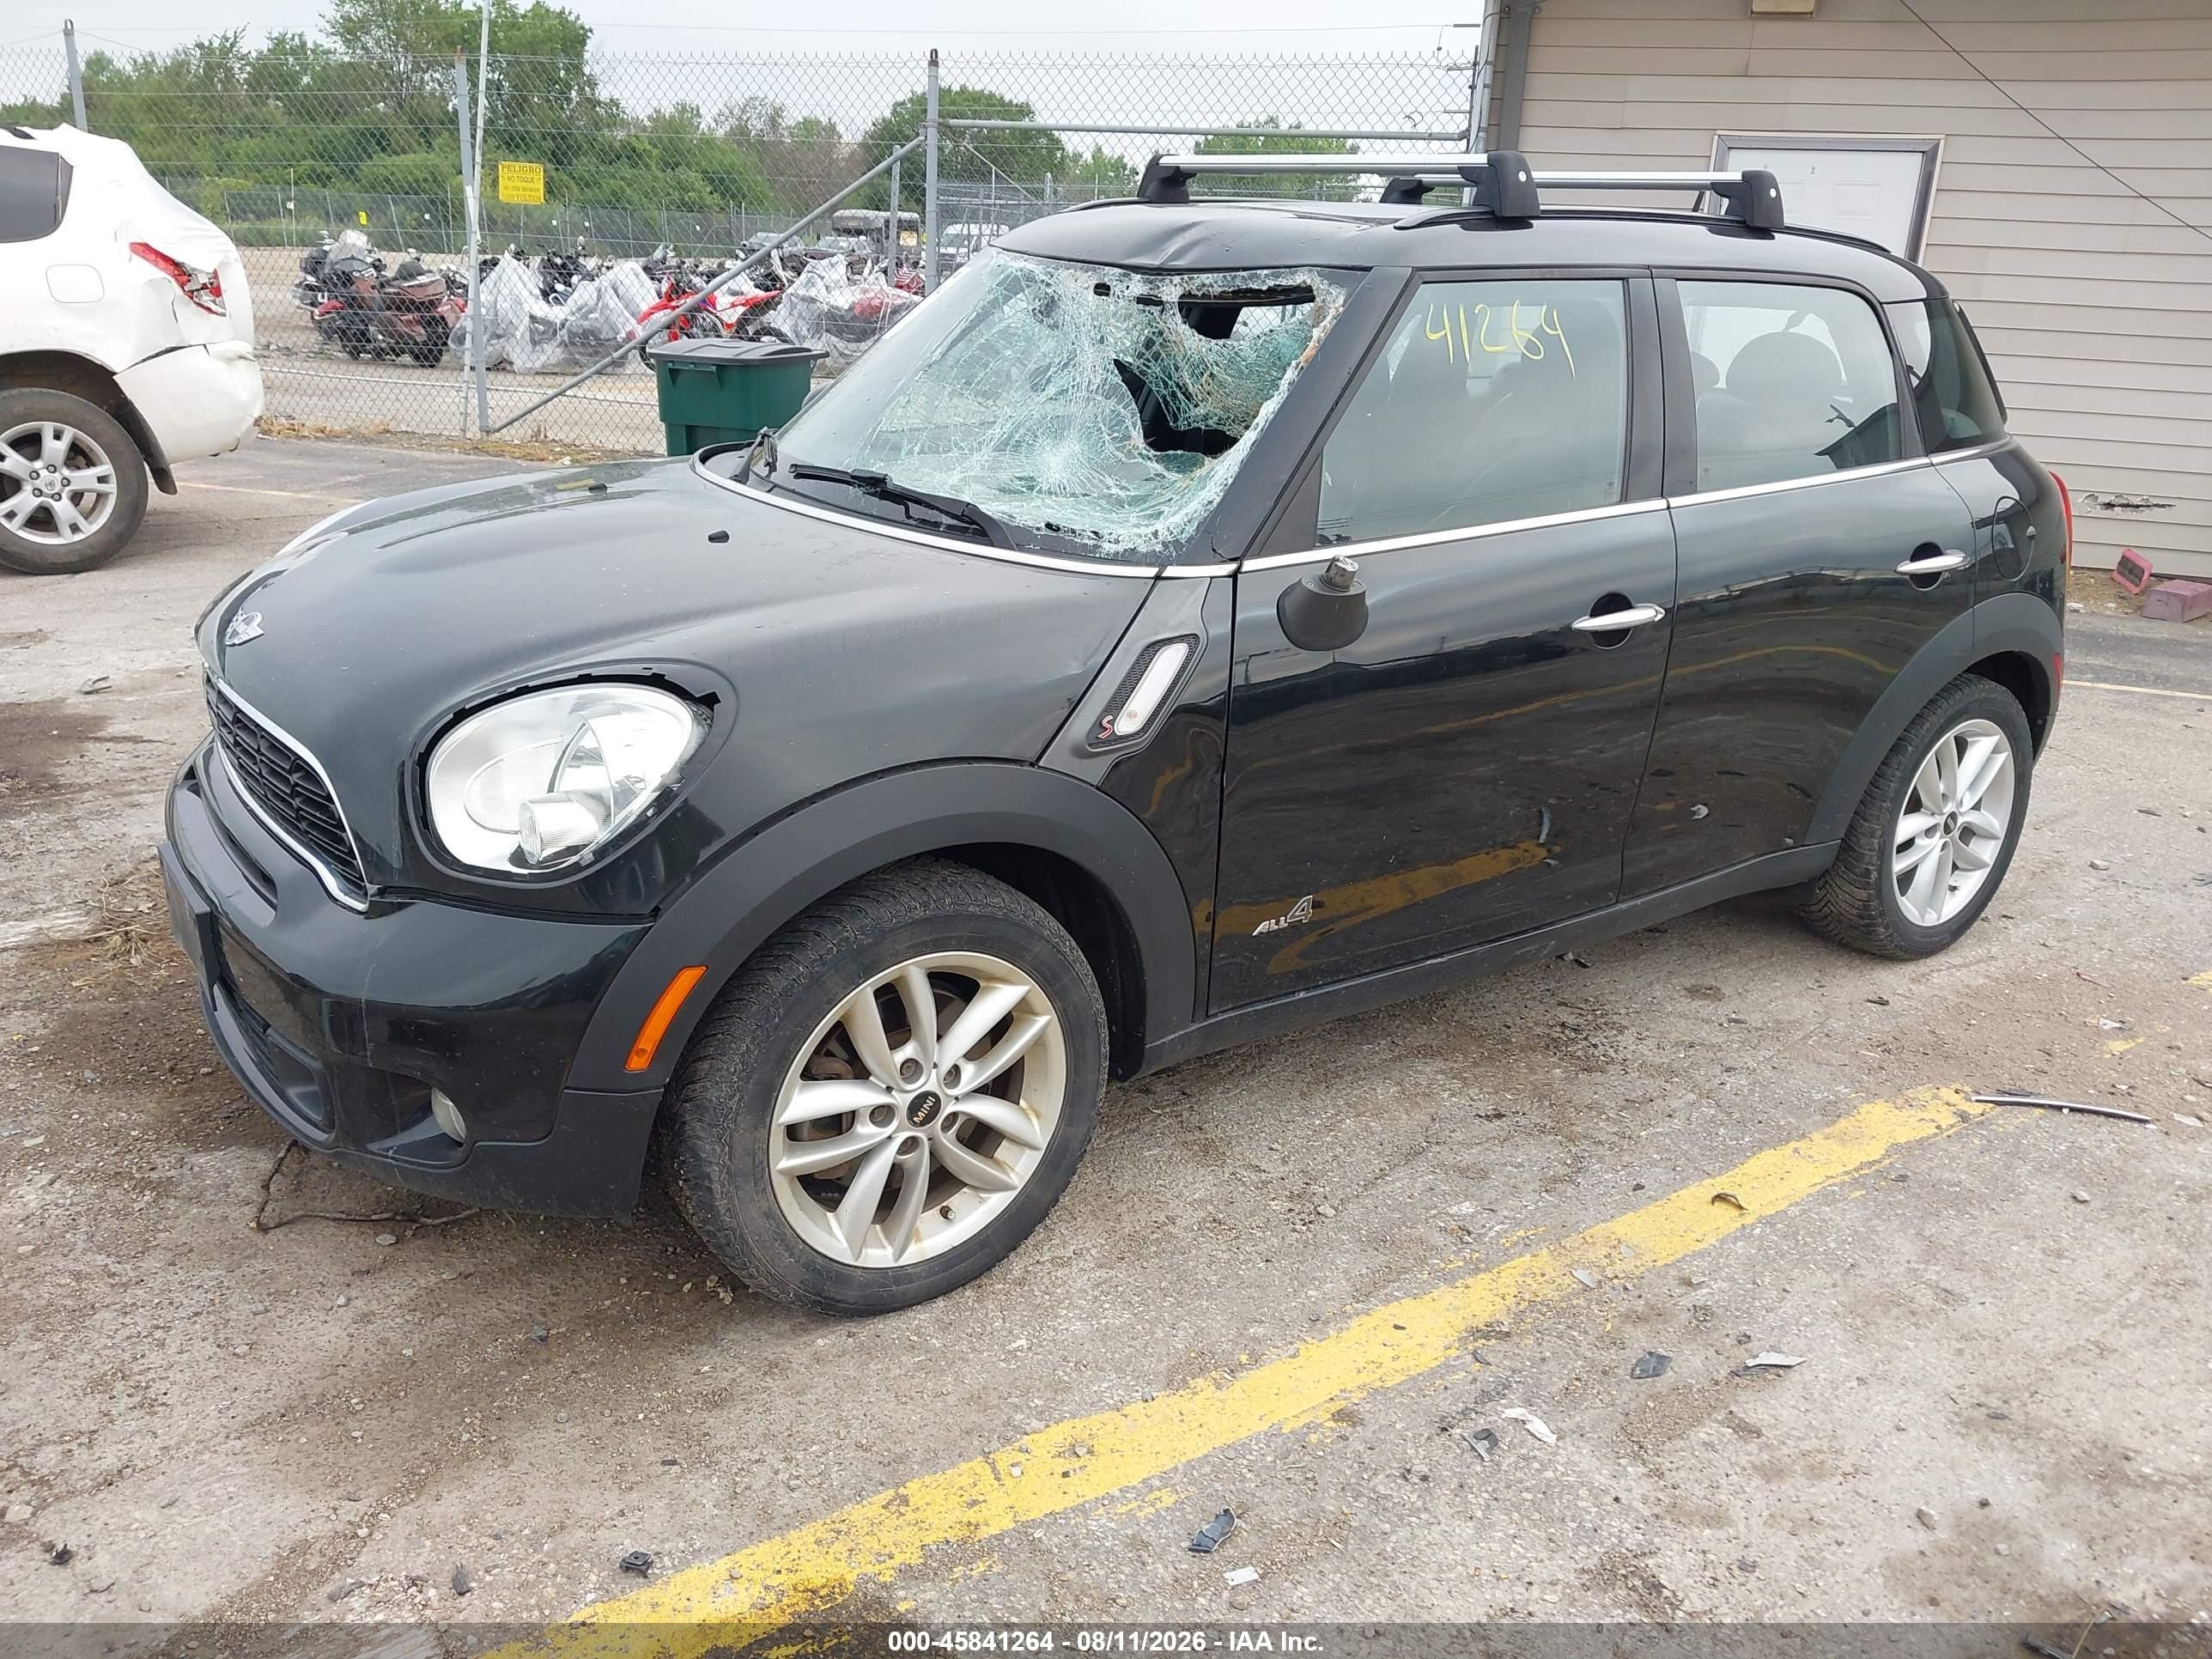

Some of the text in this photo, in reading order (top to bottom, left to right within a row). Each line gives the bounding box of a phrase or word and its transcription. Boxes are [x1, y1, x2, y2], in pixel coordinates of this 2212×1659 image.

[501, 165, 541, 173] PELIGRO
[1425, 301, 1576, 379] 41264
[1097, 714, 1114, 739] S
[912, 1096, 936, 1124] MINI
